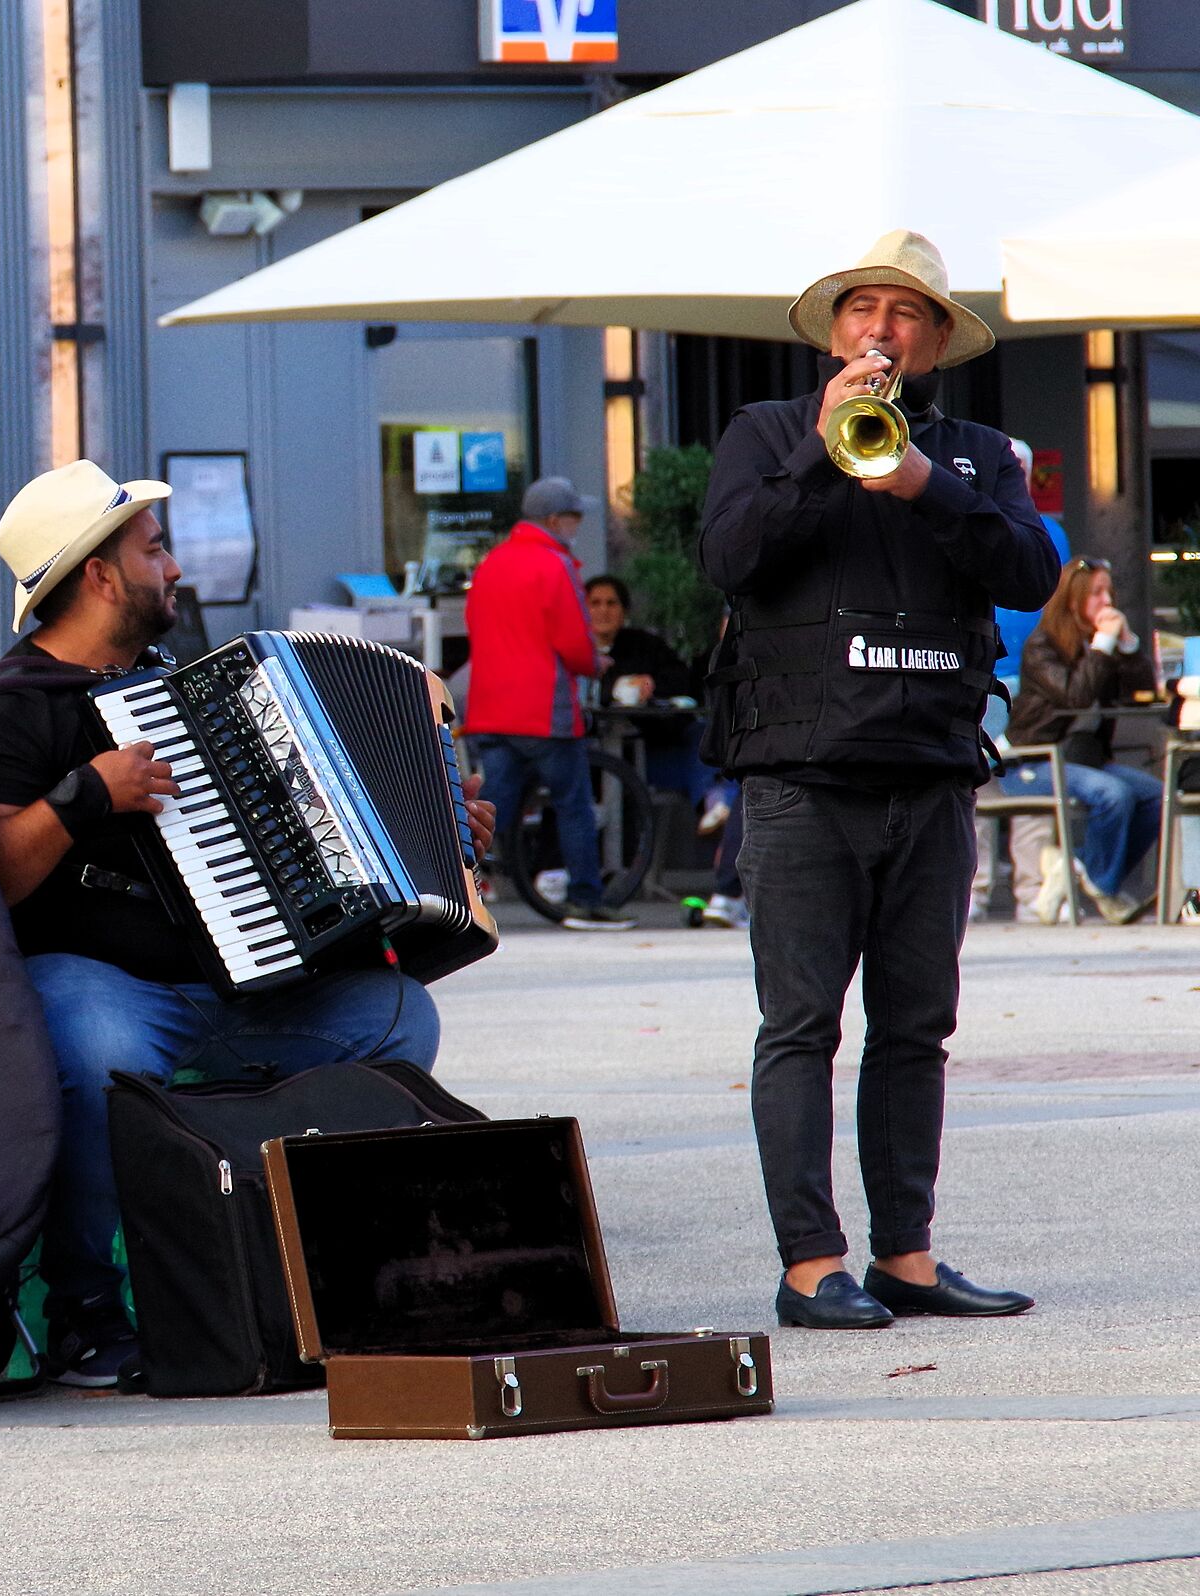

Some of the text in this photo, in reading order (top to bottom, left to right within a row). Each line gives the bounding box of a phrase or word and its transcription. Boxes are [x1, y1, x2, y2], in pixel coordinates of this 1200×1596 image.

[867, 646, 960, 670] KARL LAGERFELD
[328, 738, 364, 800] Roland
